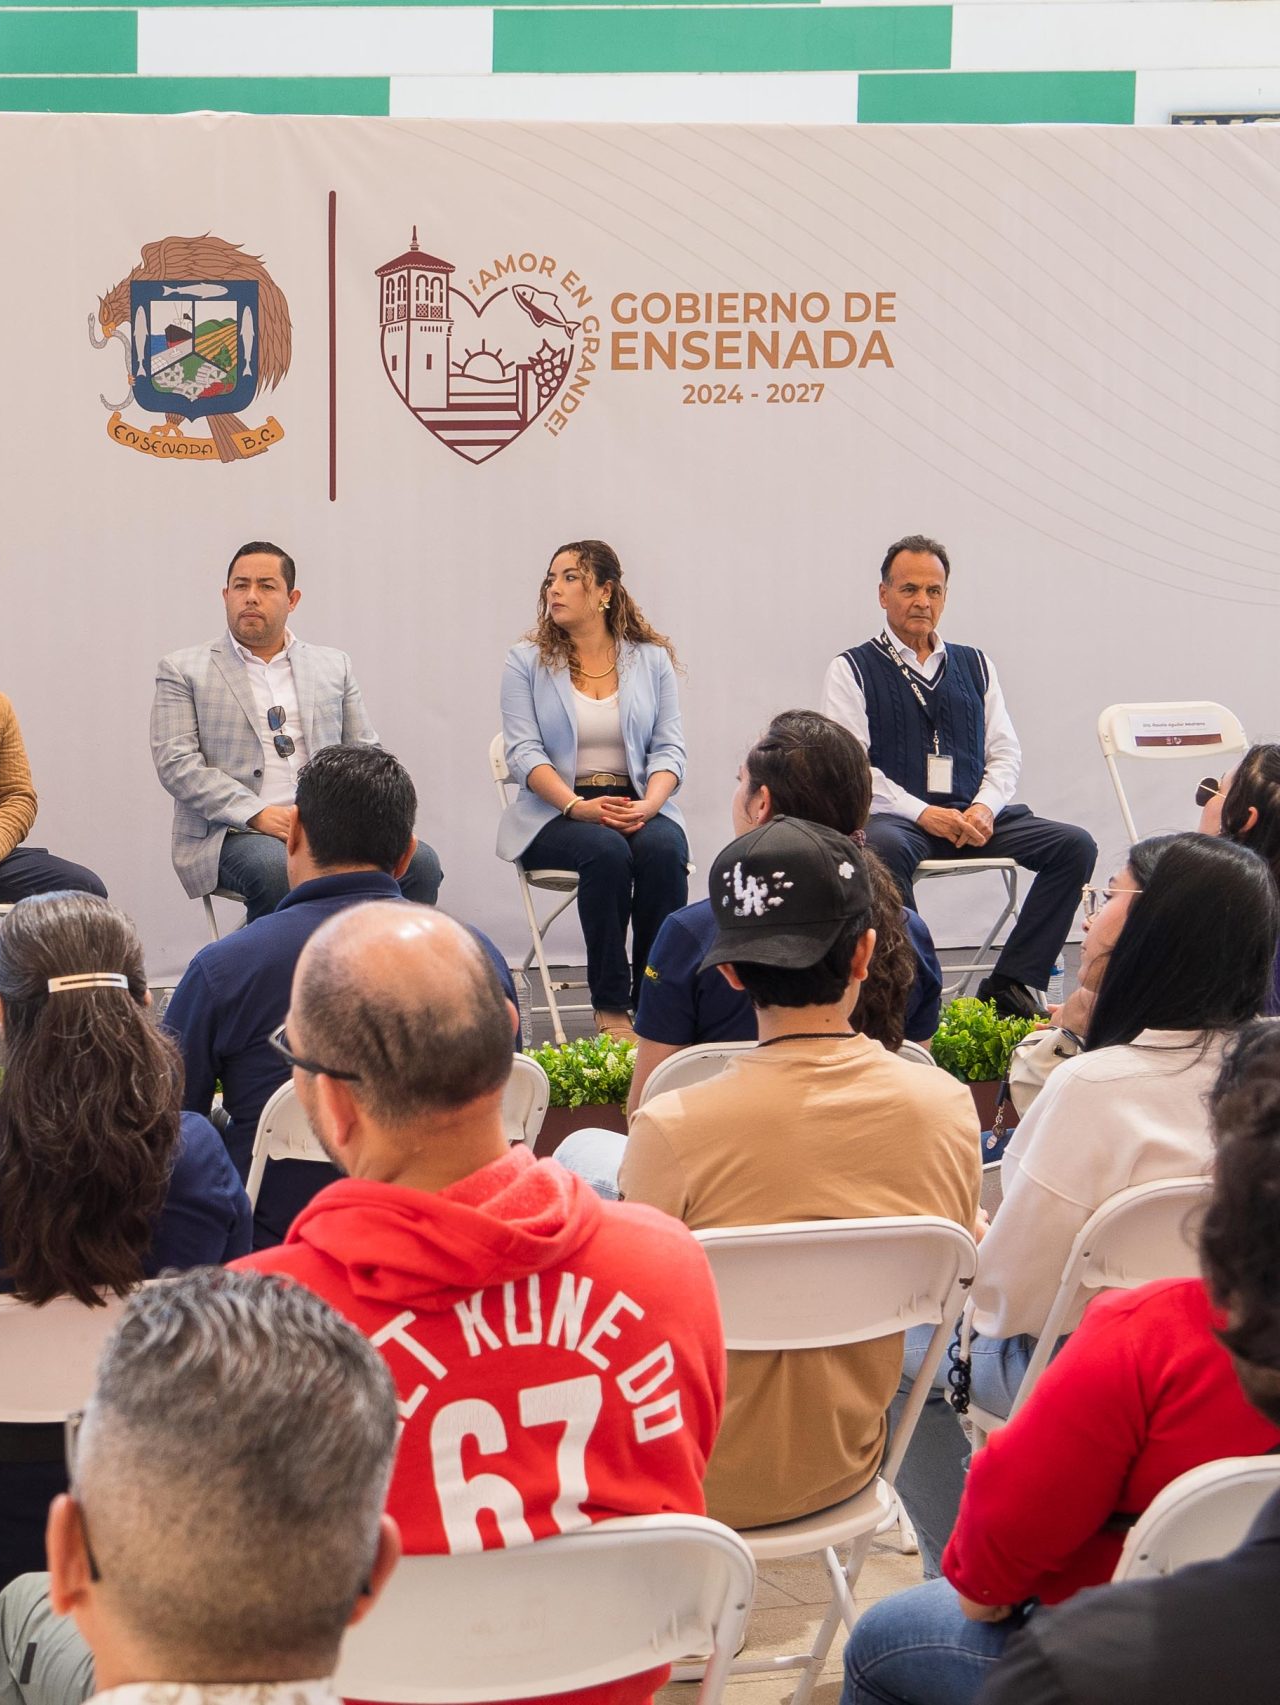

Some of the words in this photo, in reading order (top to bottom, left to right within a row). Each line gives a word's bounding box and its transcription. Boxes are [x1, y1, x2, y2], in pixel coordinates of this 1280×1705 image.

[468, 252, 556, 296] ¡AMOR
[560, 270, 593, 308] EN
[610, 291, 830, 325] GOBIERNO
[844, 291, 897, 323] DE
[610, 330, 895, 371] ENSENADA
[543, 315, 600, 437] GRANDE!
[682, 384, 744, 404] 2024
[766, 383, 825, 404] 2027
[114, 425, 213, 455] ENSENADA
[241, 428, 275, 450] B.C.
[454, 1271, 645, 1371] KUNE
[429, 1373, 603, 1556] 67
